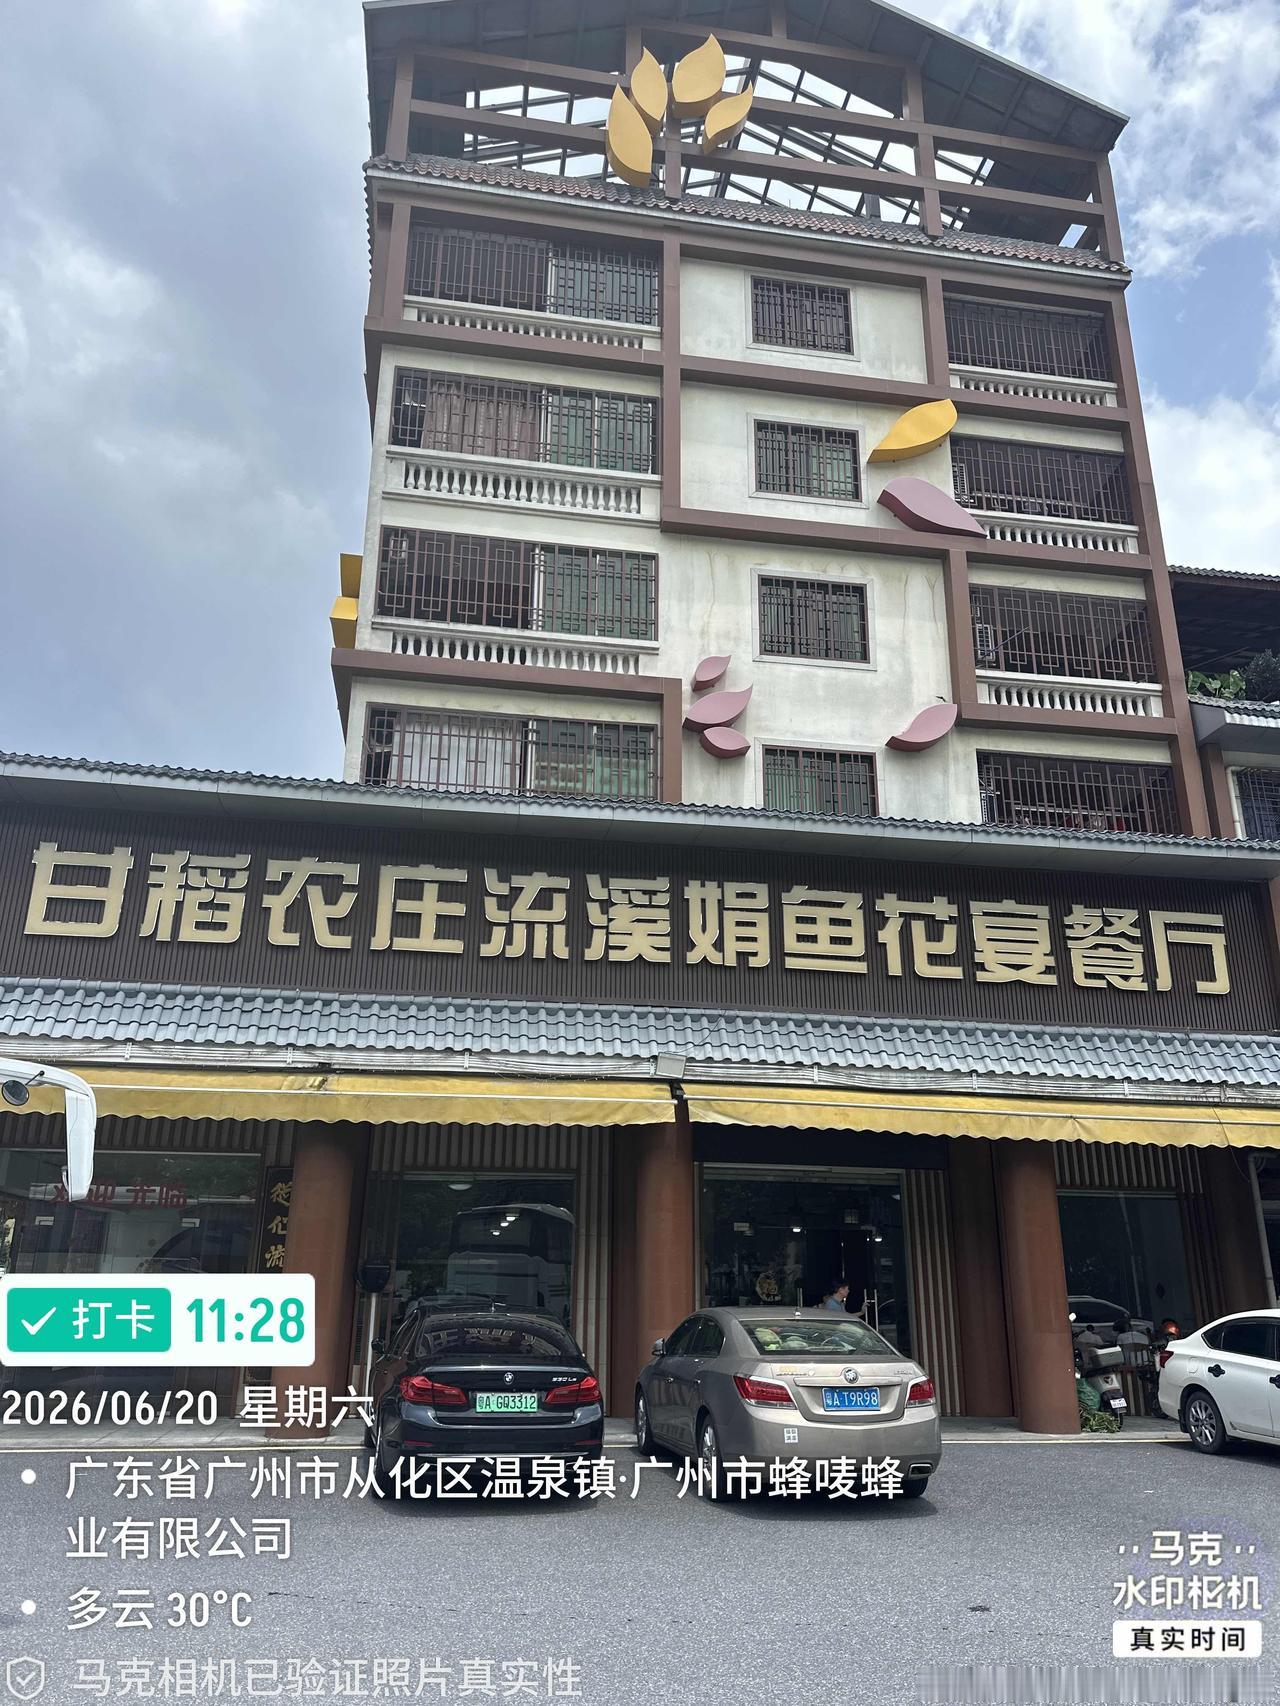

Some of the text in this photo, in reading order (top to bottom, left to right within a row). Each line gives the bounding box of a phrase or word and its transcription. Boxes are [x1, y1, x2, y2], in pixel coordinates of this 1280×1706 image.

[24, 841, 1231, 995] 甘稻农庄流溪娟鱼花宴餐厅
